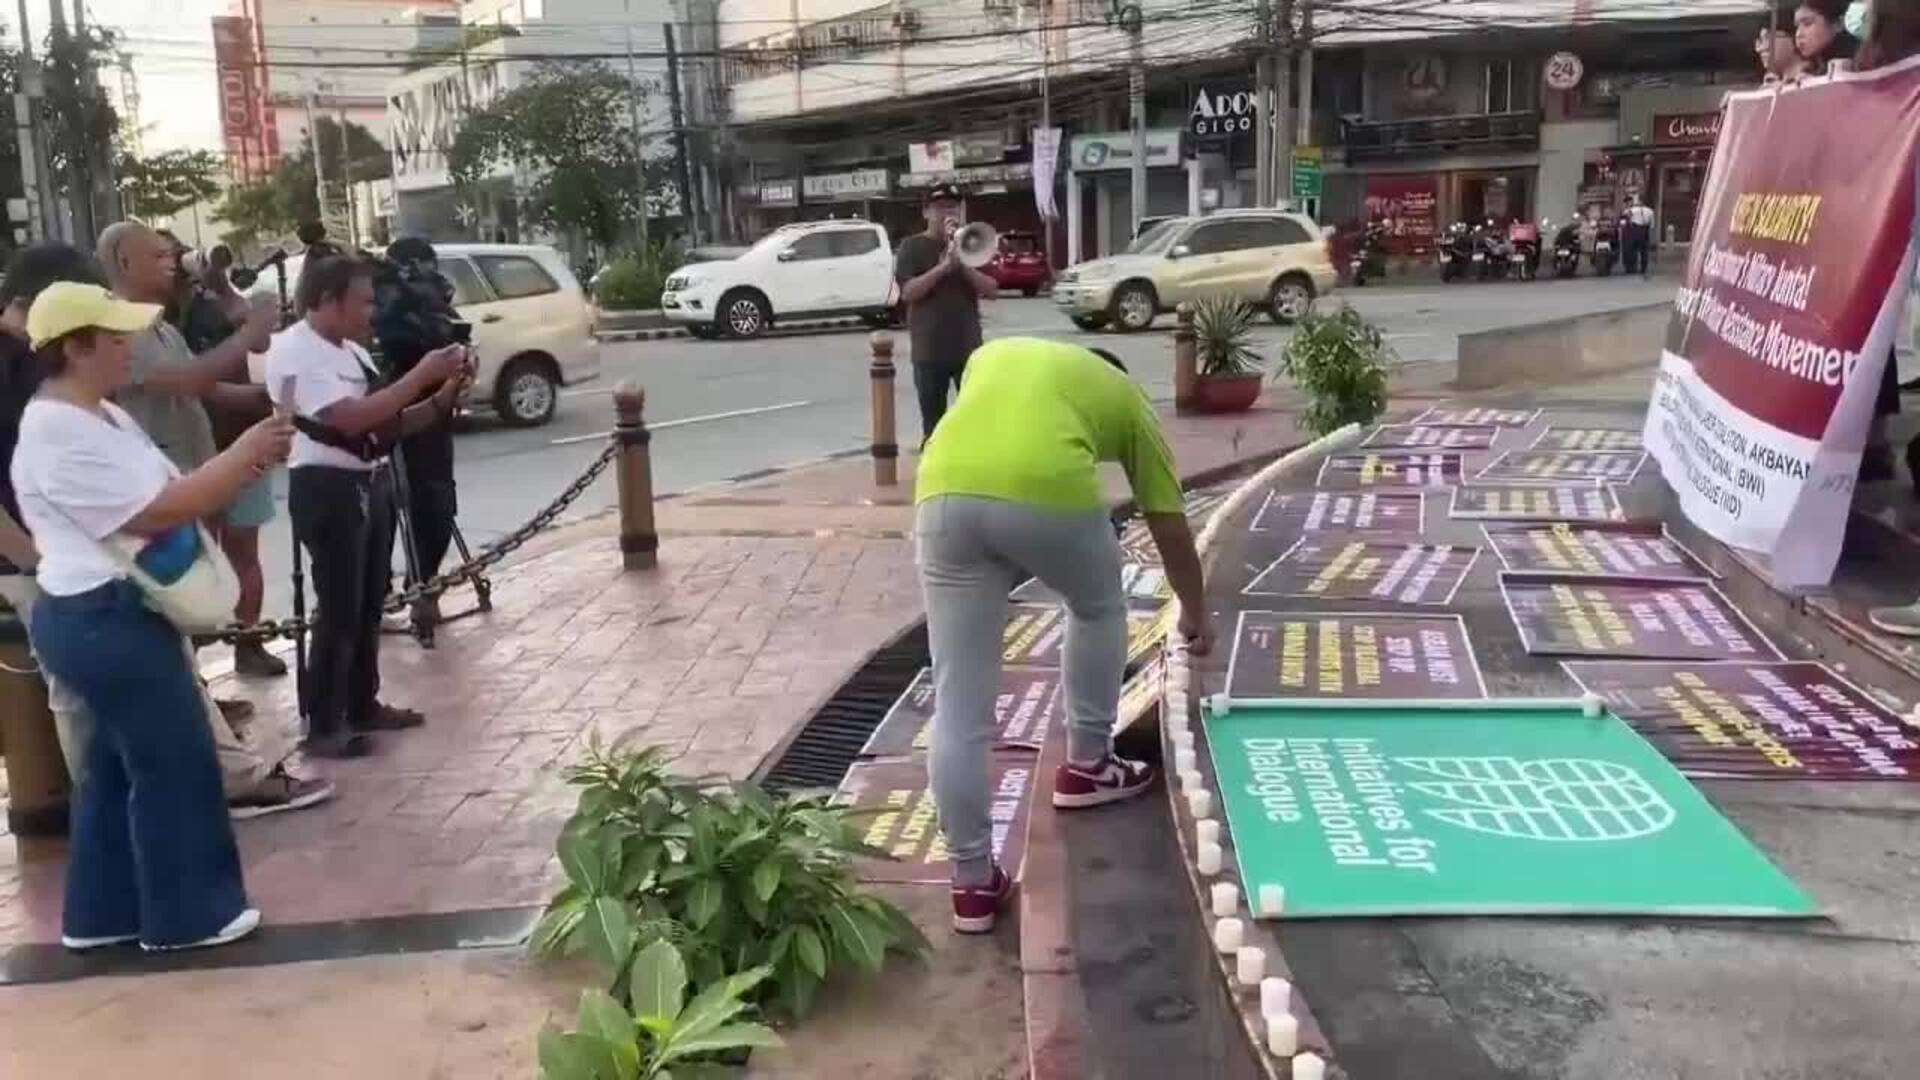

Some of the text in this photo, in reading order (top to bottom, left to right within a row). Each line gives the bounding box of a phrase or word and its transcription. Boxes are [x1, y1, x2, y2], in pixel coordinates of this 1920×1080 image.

[1243, 738, 1302, 822] Dialogue
[1287, 738, 1389, 865] International
[1332, 738, 1437, 873] Initiatives for
